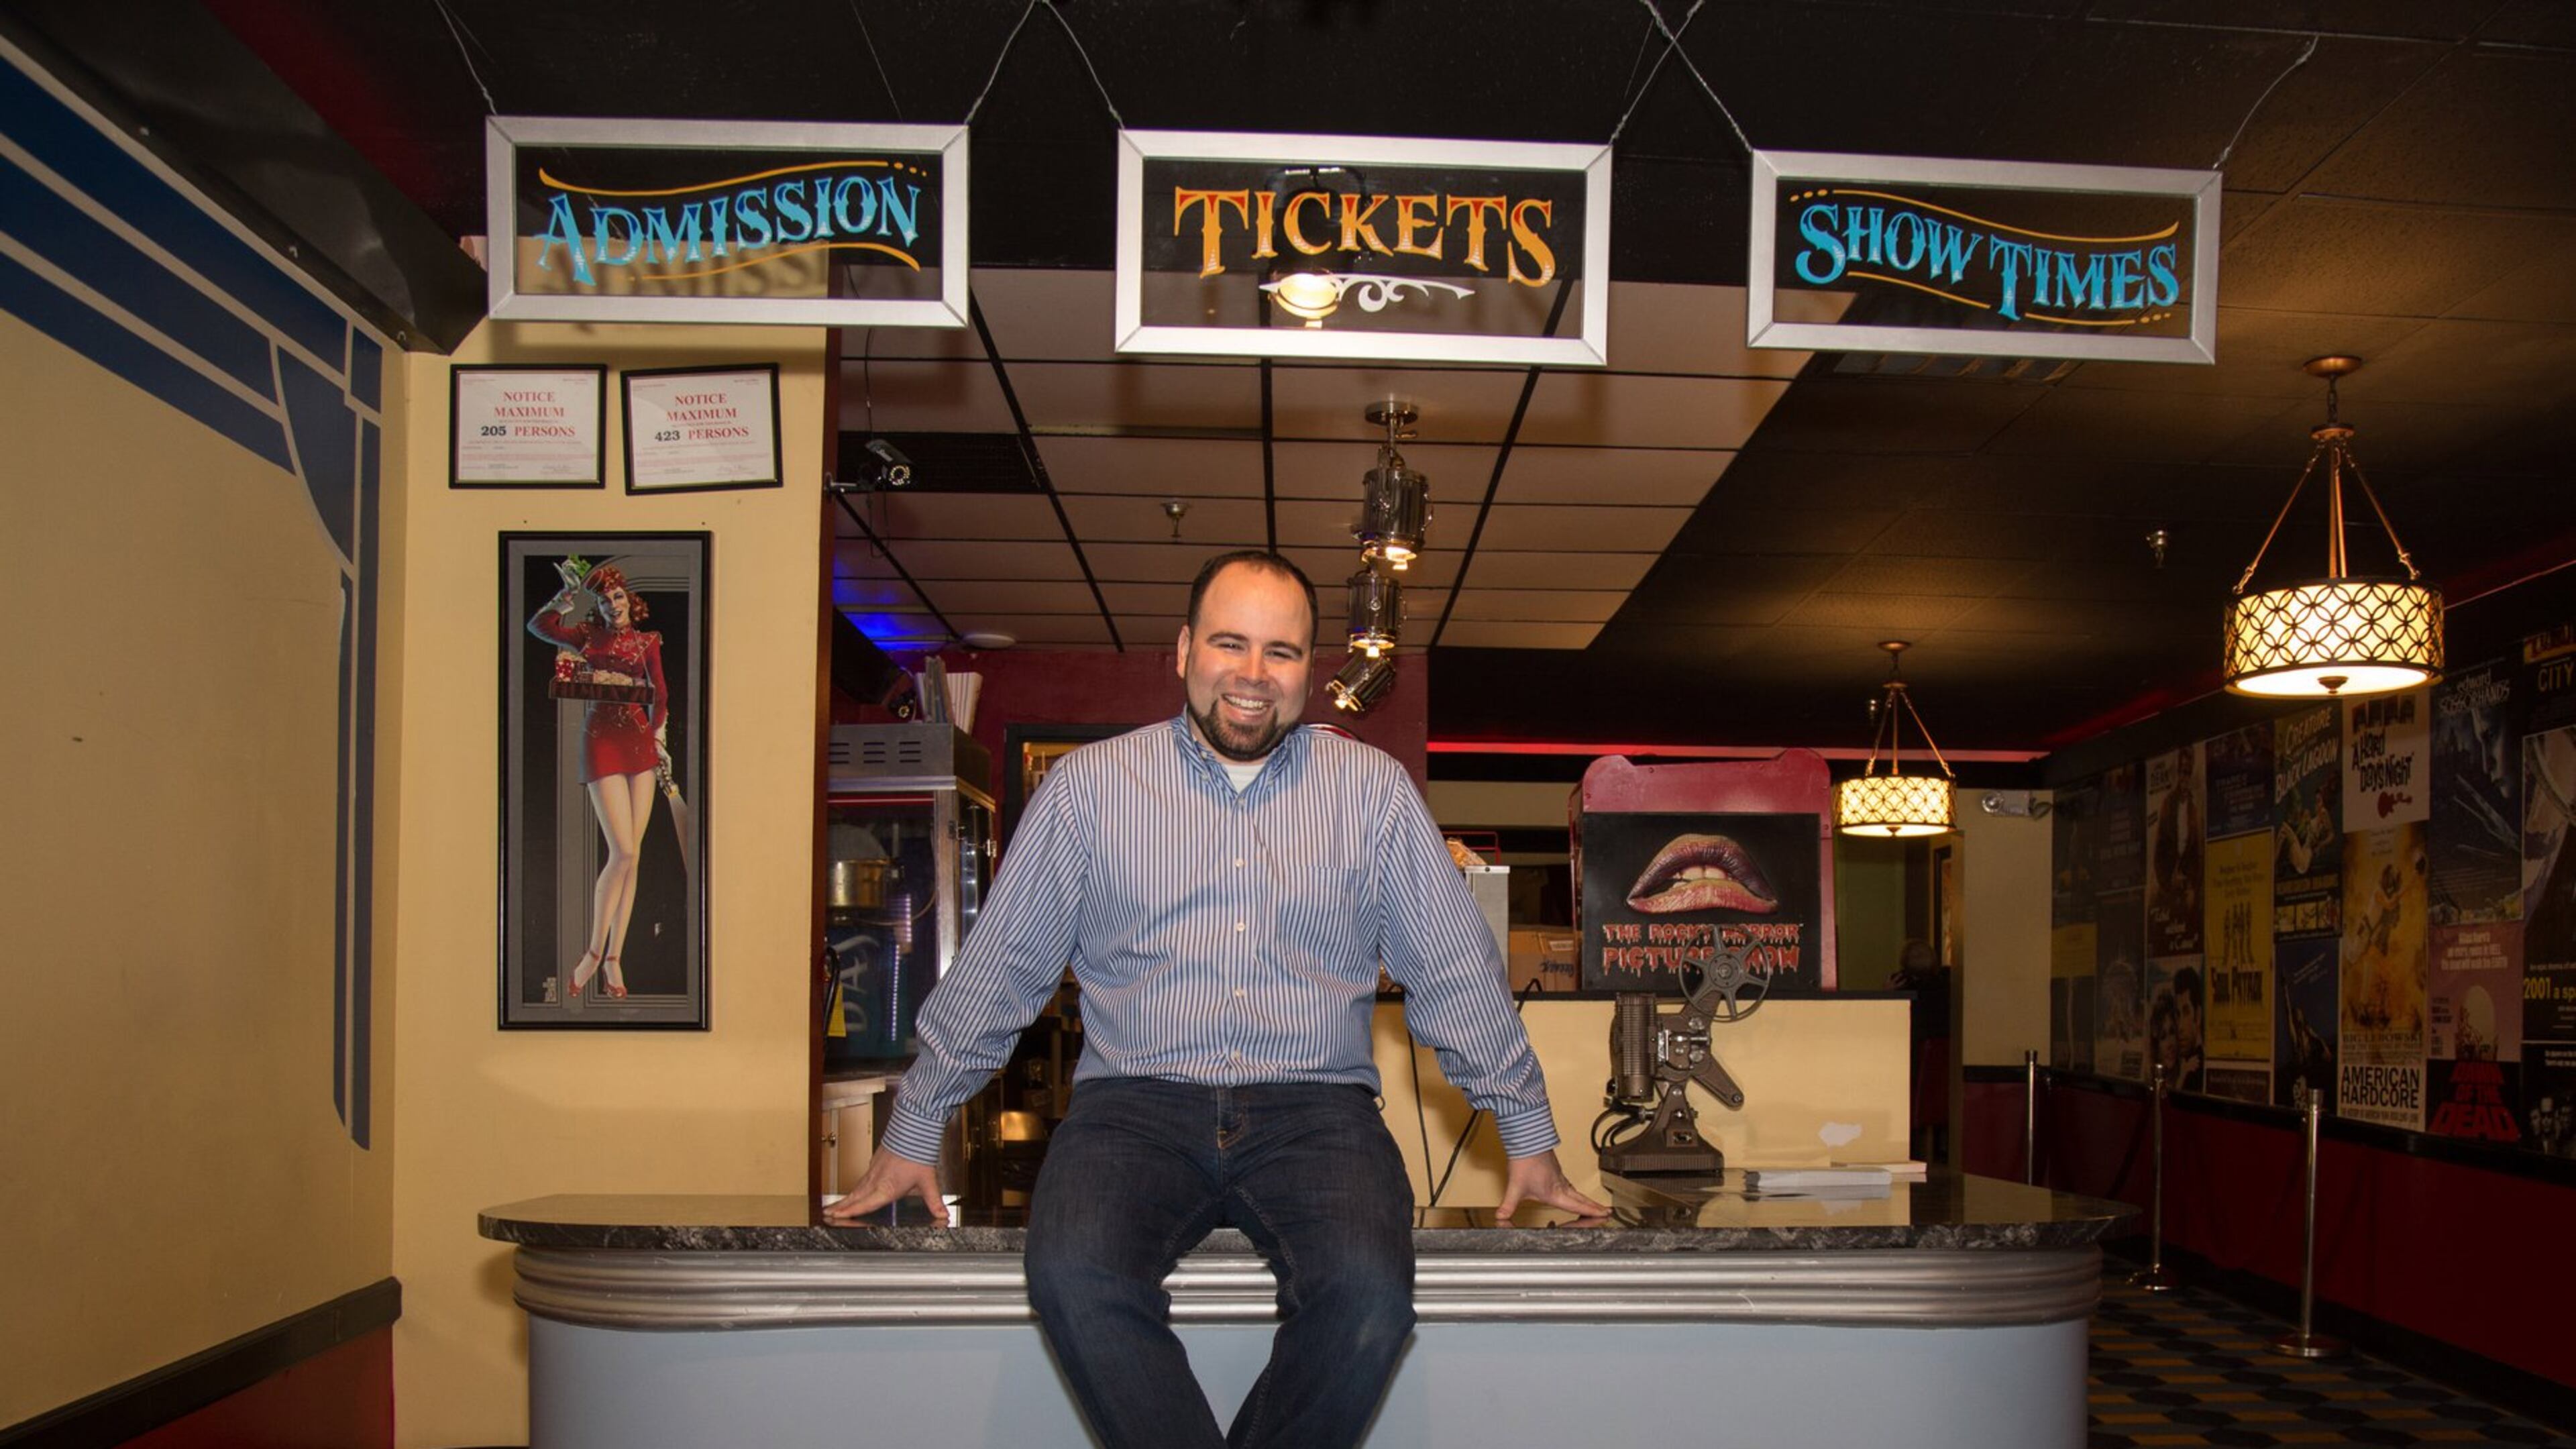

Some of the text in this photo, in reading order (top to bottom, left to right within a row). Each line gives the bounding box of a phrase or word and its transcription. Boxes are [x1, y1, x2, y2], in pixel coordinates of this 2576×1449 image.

[536, 175, 922, 286] ADMISSION
[1173, 186, 1556, 288] TICKETS
[1794, 203, 2180, 321] SHOW TIMES
[503, 391, 555, 402] NOTICE
[675, 393, 727, 407] NOTICE
[494, 407, 565, 417] MAXIMUM
[667, 408, 737, 422] MAXIMUM
[481, 425, 576, 437] 205 PERSONS
[655, 426, 749, 442] 423 PERSONS
[1602, 924, 1642, 945] THE
[1648, 924, 1715, 947] ROCKY
[2523, 976, 2551, 1000] 2001
[2341, 1065, 2420, 1088] AMERICAN
[2341, 1085, 2419, 1109] HARDCORE
[2428, 1101, 2523, 1143] DEAD
